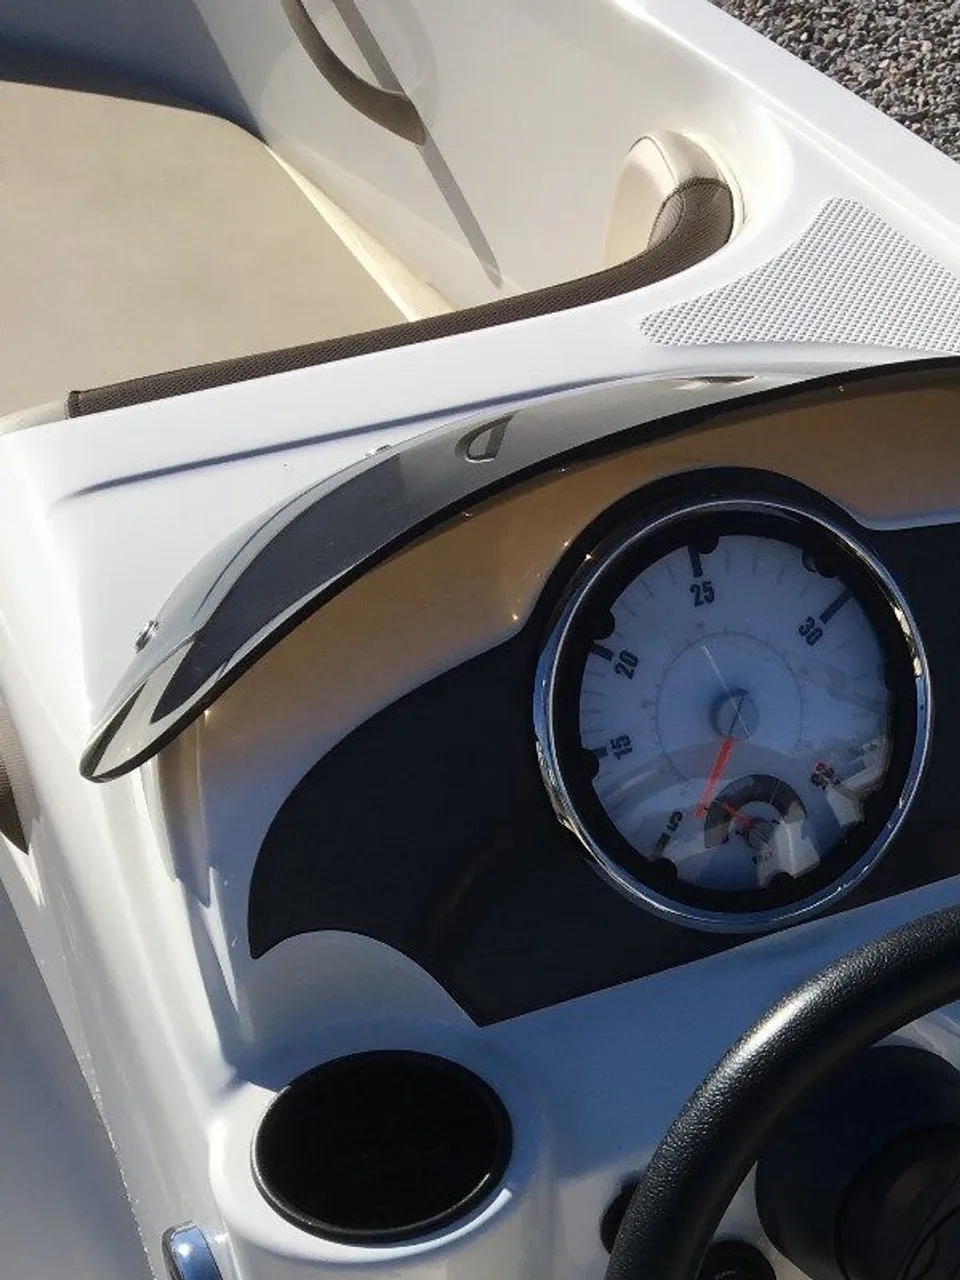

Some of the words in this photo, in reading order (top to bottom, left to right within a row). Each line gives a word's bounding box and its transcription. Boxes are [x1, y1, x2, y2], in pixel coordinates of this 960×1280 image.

[690, 580, 716, 608] 25
[799, 615, 824, 646] 30
[614, 649, 641, 681] 20
